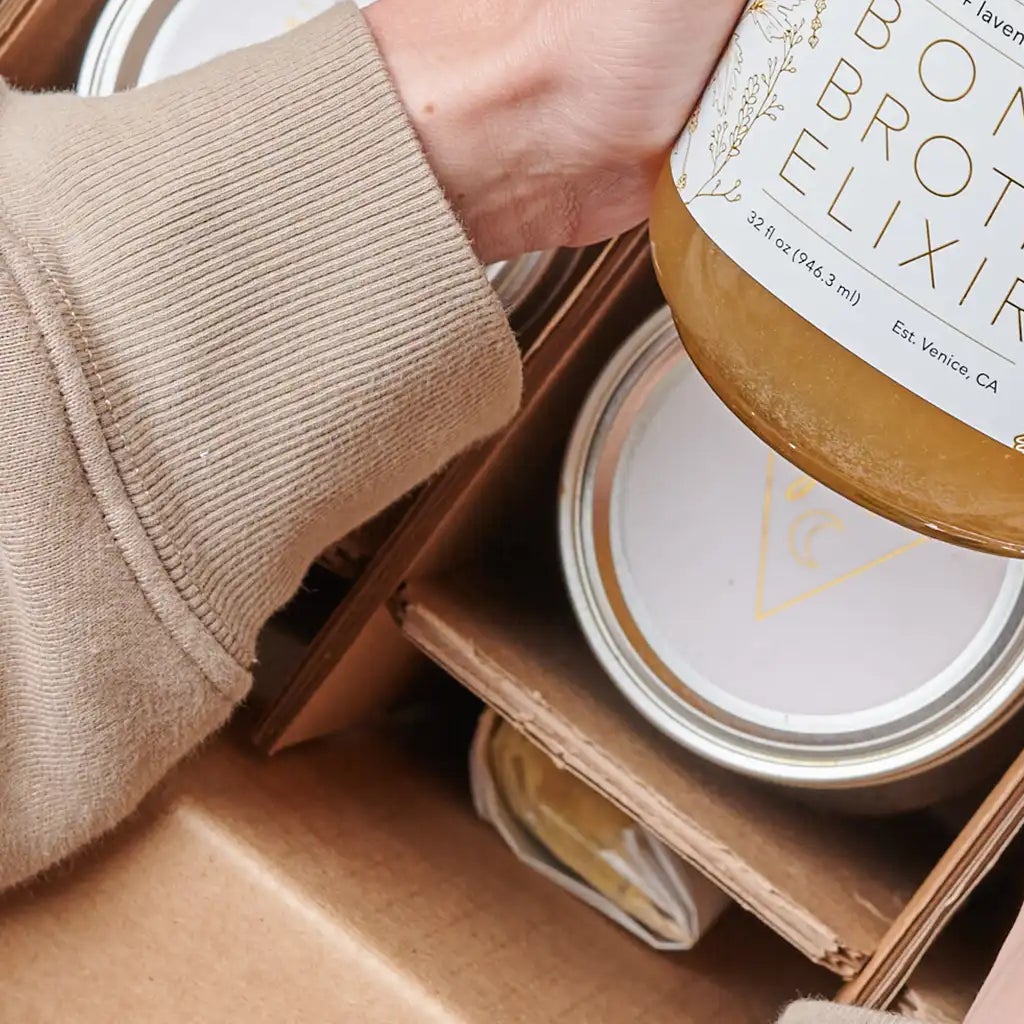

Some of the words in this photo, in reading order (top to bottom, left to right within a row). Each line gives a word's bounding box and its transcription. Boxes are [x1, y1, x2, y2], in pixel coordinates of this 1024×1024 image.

[746, 210, 765, 232] 32
[764, 225, 776, 240] fl
[775, 238, 792, 255] oz
[891, 319, 916, 345] Est.
[920, 337, 971, 380] Venice,
[975, 372, 999, 394] CA
